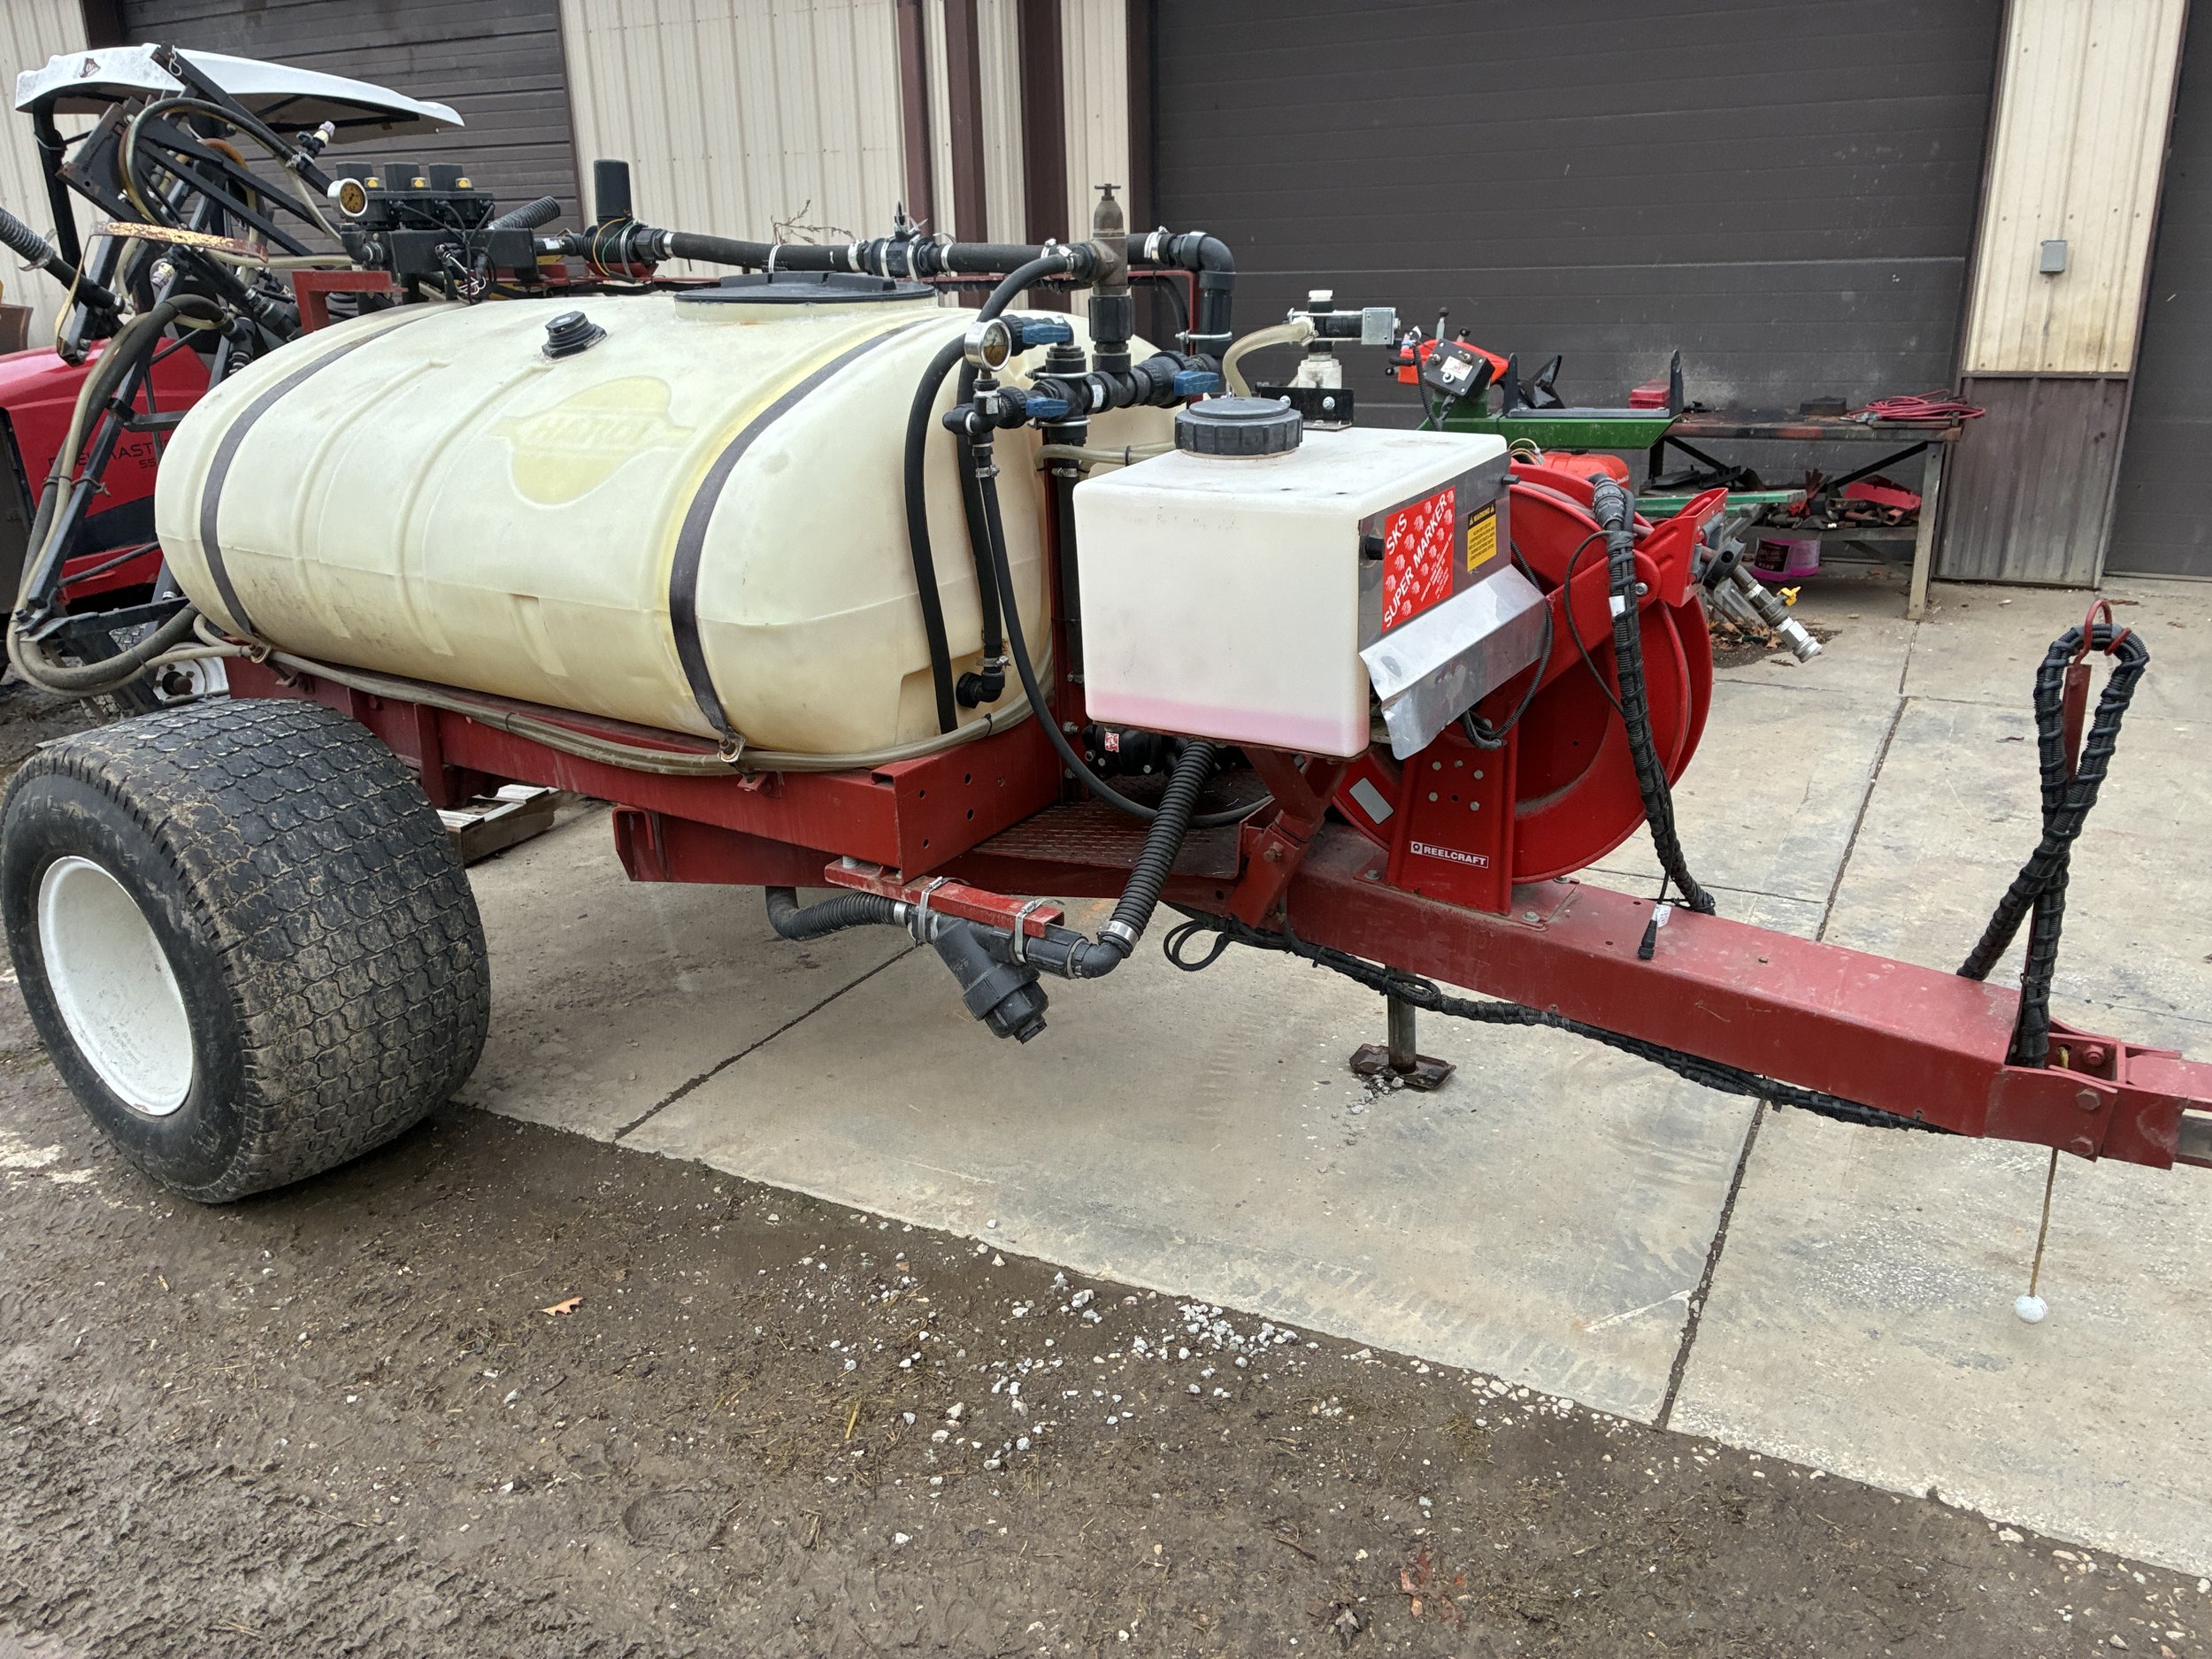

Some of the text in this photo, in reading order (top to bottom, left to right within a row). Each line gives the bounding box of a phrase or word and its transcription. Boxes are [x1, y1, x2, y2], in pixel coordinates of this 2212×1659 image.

[1386, 512, 1408, 556] SKS
[1384, 565, 1414, 628] SUPER
[1412, 493, 1448, 569] MARKER
[1423, 846, 1486, 865] REELCRAFT
